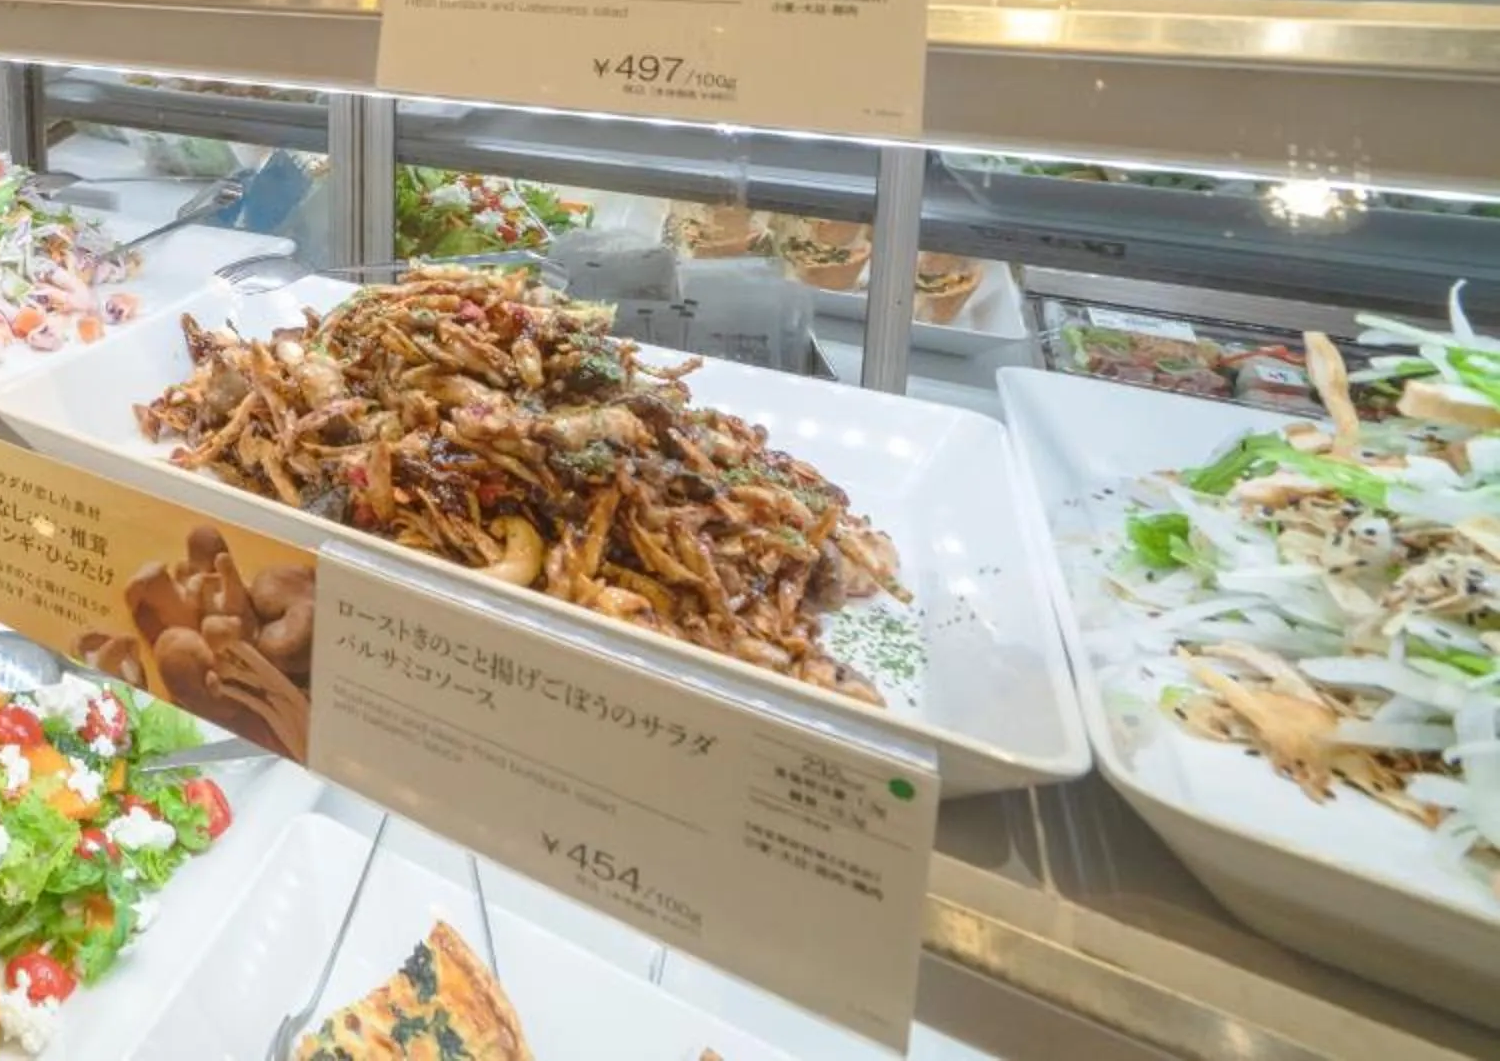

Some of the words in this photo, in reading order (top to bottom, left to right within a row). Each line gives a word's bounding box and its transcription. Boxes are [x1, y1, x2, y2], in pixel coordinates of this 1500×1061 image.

[337, 635, 498, 711] バルサミコソース
[337, 599, 720, 757] ローストきのこと揚げごぼうのサラダ
